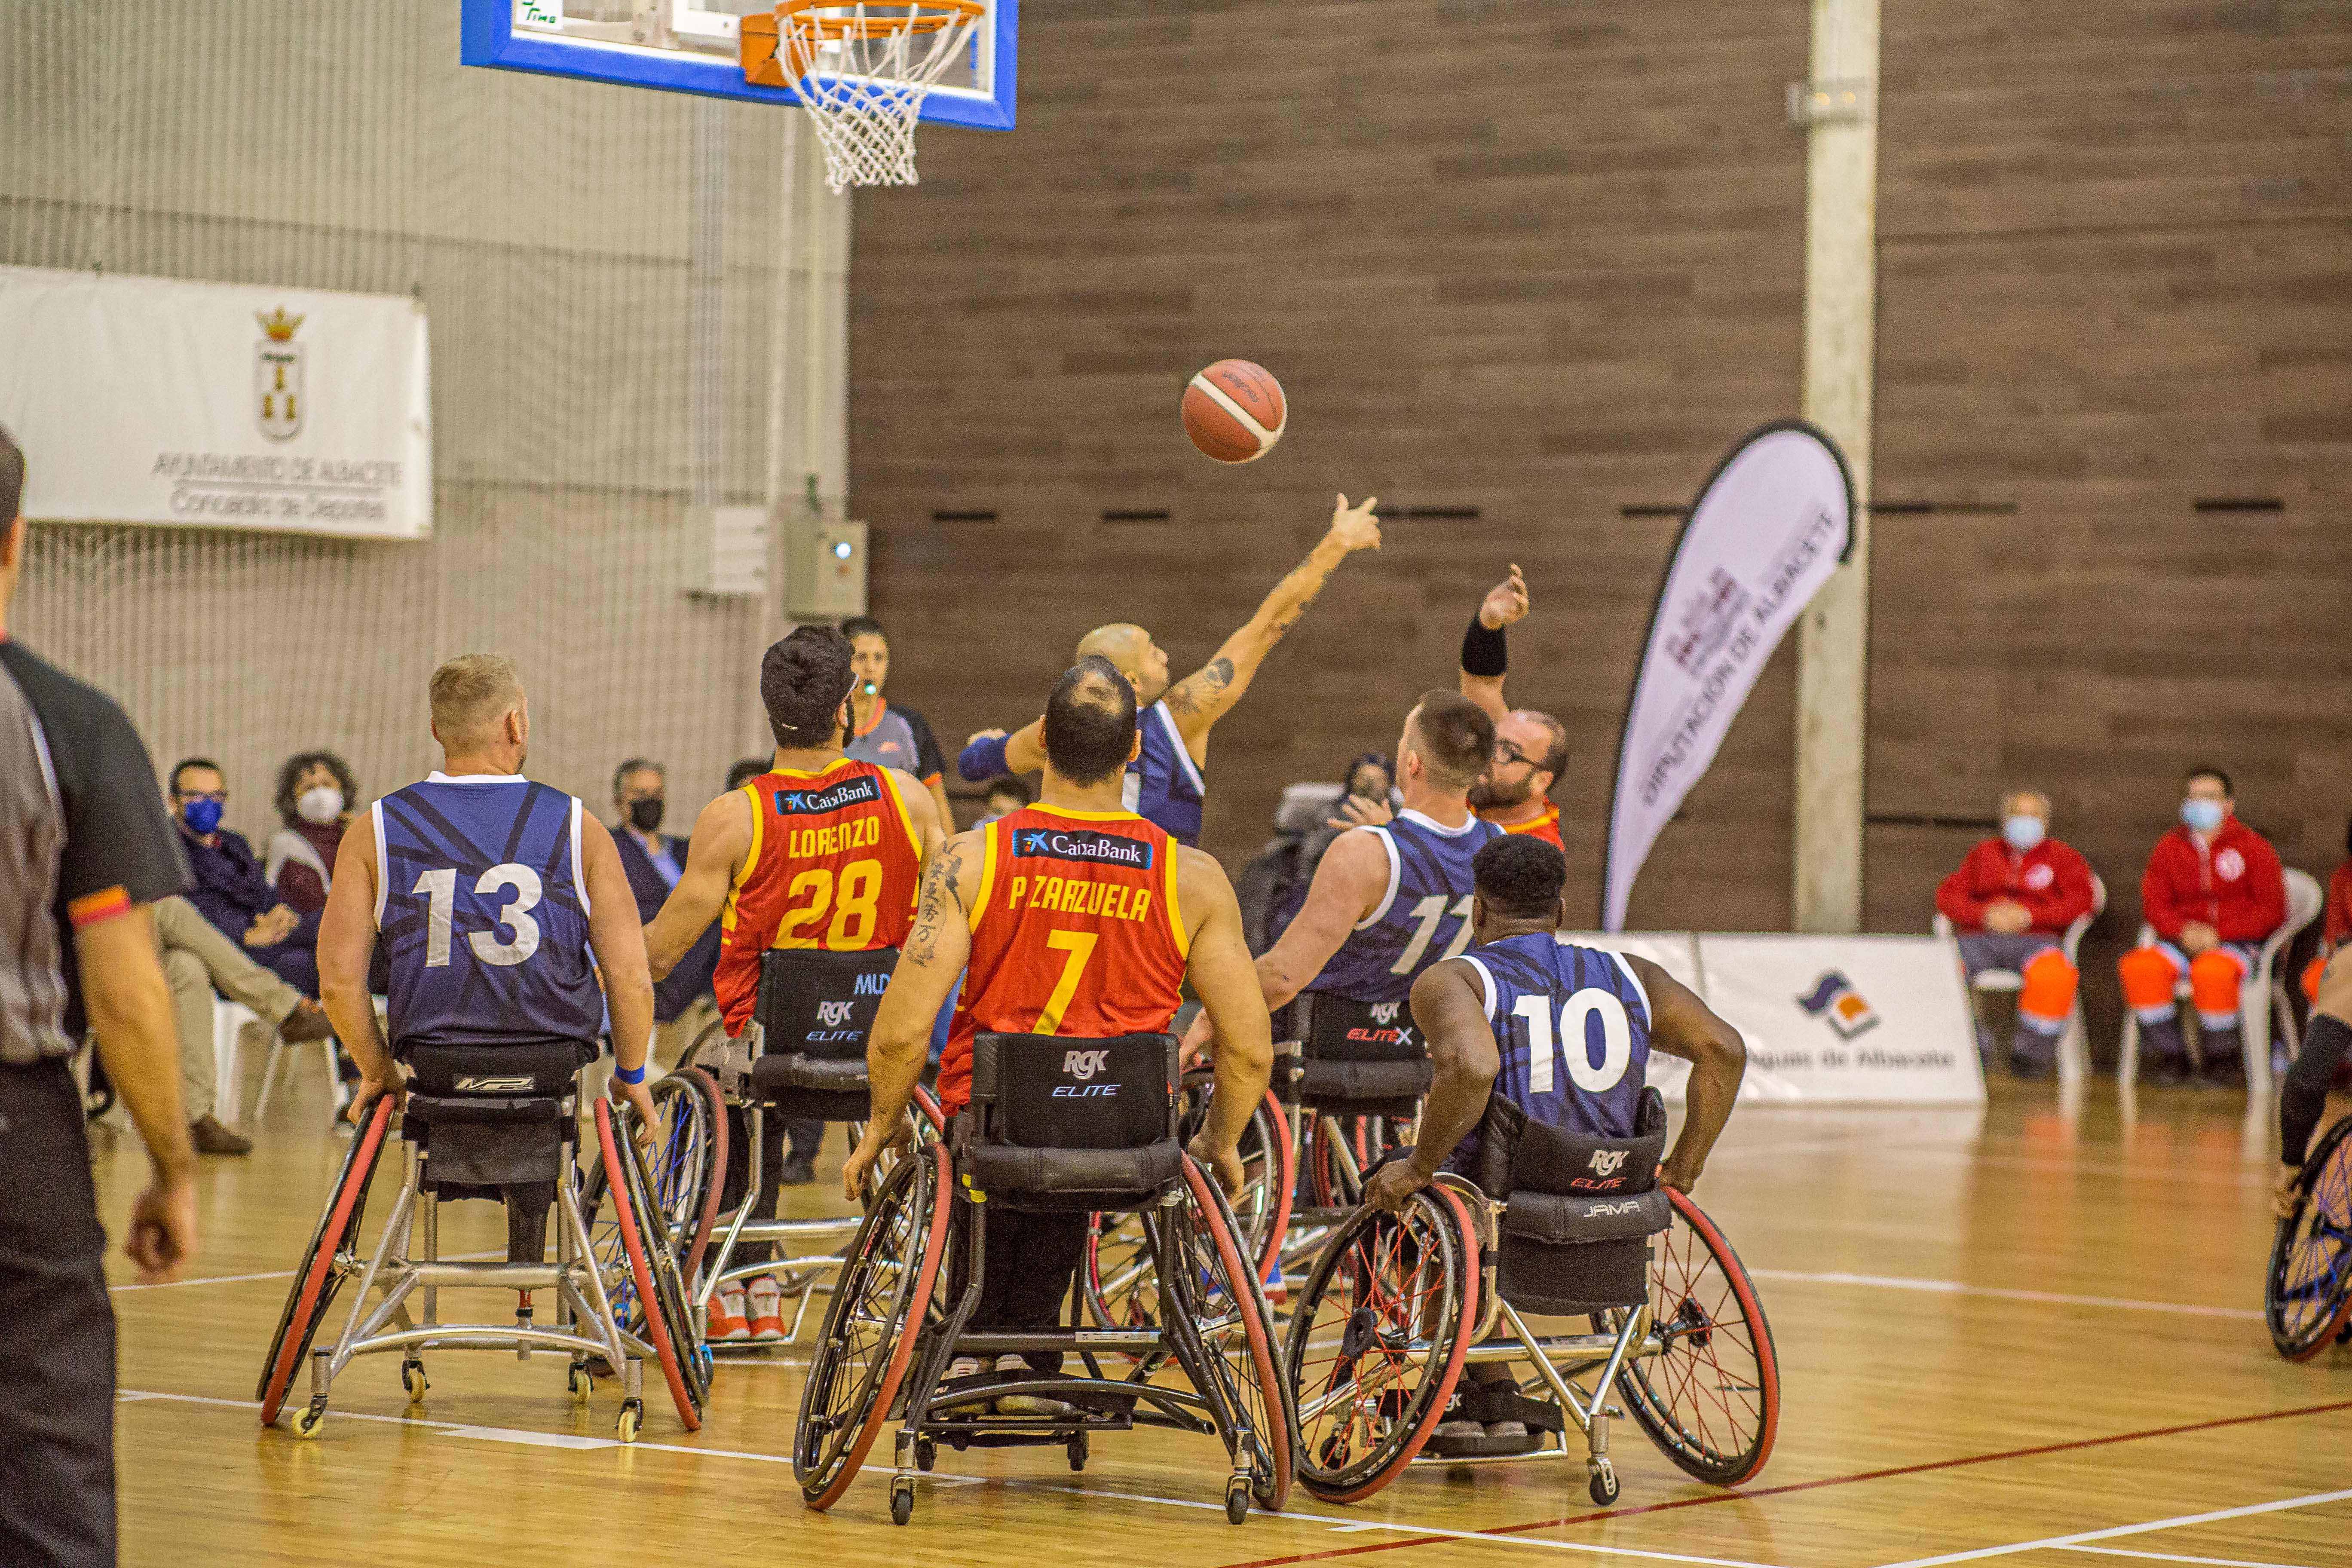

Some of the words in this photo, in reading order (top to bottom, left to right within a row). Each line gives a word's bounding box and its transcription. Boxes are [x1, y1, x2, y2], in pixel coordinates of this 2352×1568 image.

[1731, 626, 1759, 664] DE
[1754, 512, 1836, 626] ALBACETE
[789, 816, 879, 858] LORENZO
[1051, 836, 1142, 862] CaixaBank
[411, 863, 543, 967] 13
[772, 859, 882, 952] 28
[1390, 894, 1474, 975] 11
[1032, 929, 1099, 1036] 7
[806, 1031, 864, 1041] ELITE
[1511, 987, 1632, 1093] 10
[1052, 1084, 1121, 1097] ELITE
[1571, 1177, 1627, 1189] ELITE
[1583, 1201, 1641, 1218] JAMA
